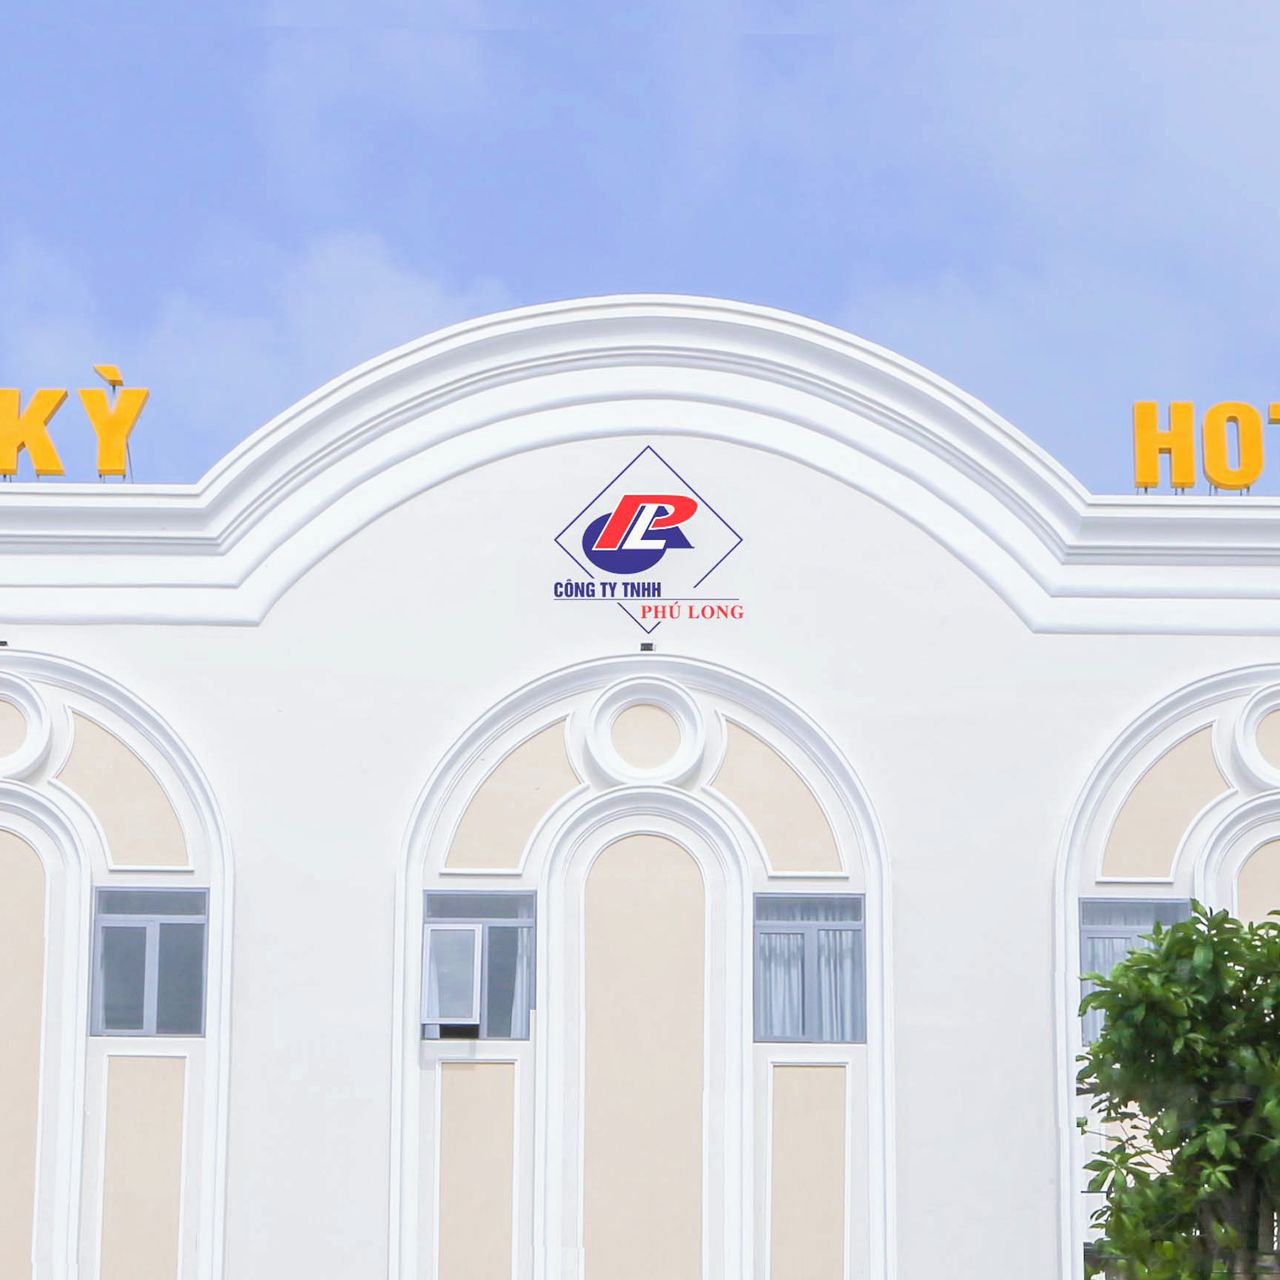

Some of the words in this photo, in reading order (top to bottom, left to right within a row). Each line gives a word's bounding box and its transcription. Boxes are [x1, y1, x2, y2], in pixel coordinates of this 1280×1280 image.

[554, 579, 595, 598] CÔNG
[600, 582, 617, 598] TY
[623, 582, 661, 598] TNHH
[641, 601, 681, 619] PHÚ
[688, 604, 744, 619] LONG
